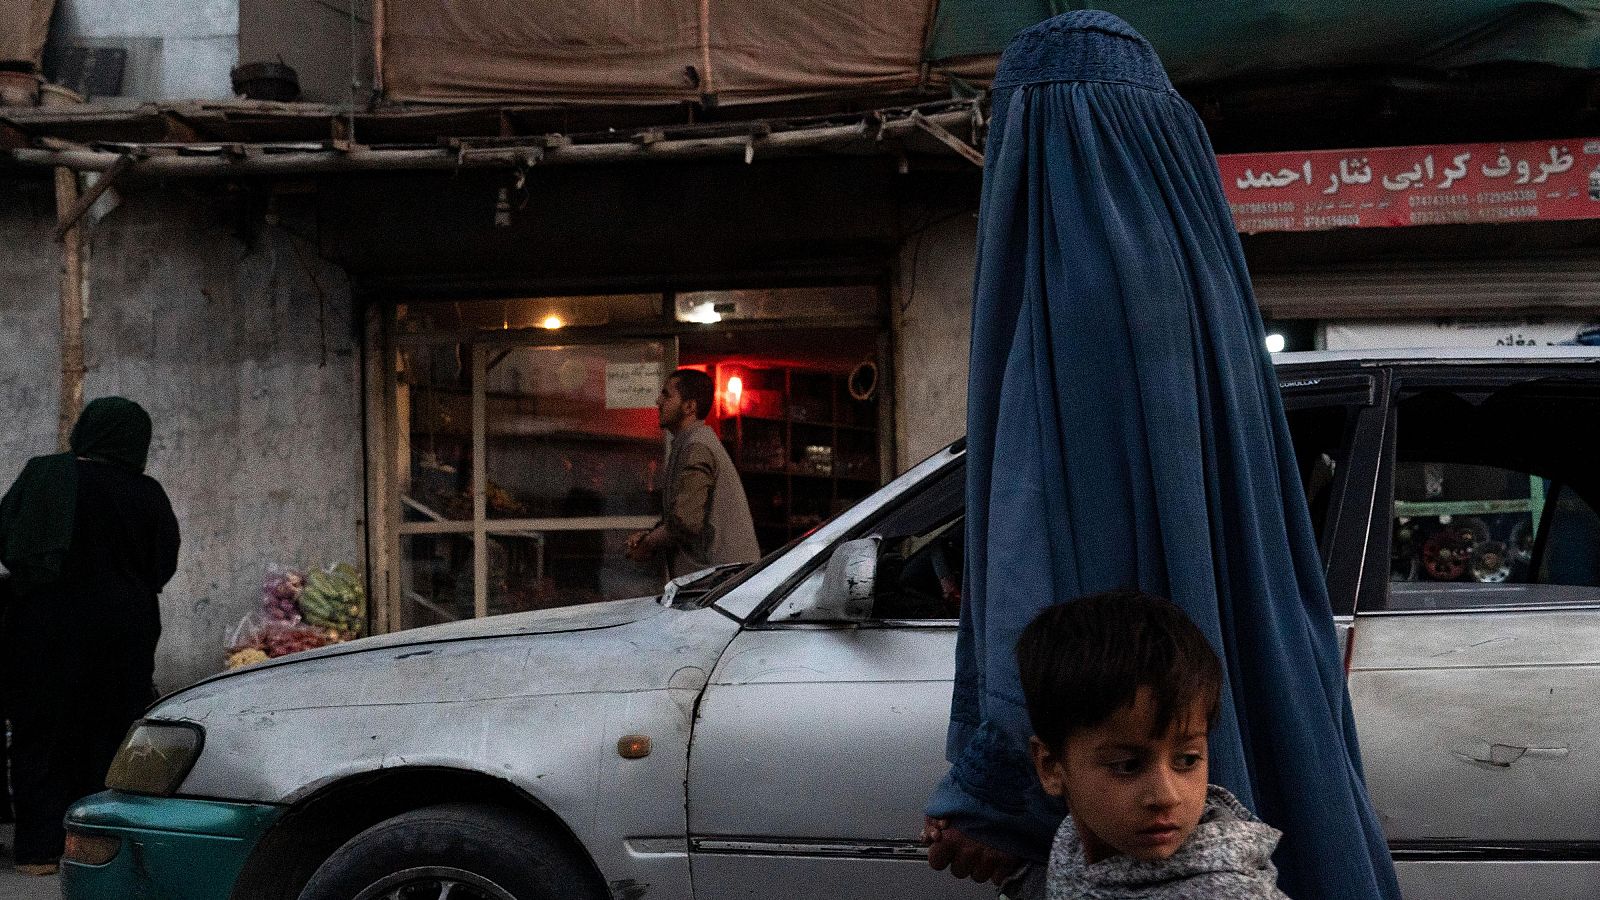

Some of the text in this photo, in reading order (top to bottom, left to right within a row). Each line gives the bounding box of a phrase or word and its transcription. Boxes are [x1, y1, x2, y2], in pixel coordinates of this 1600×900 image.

[1236, 160, 1311, 190] احمد
[1324, 157, 1373, 195] نثار
[1481, 146, 1575, 184] ظروف
